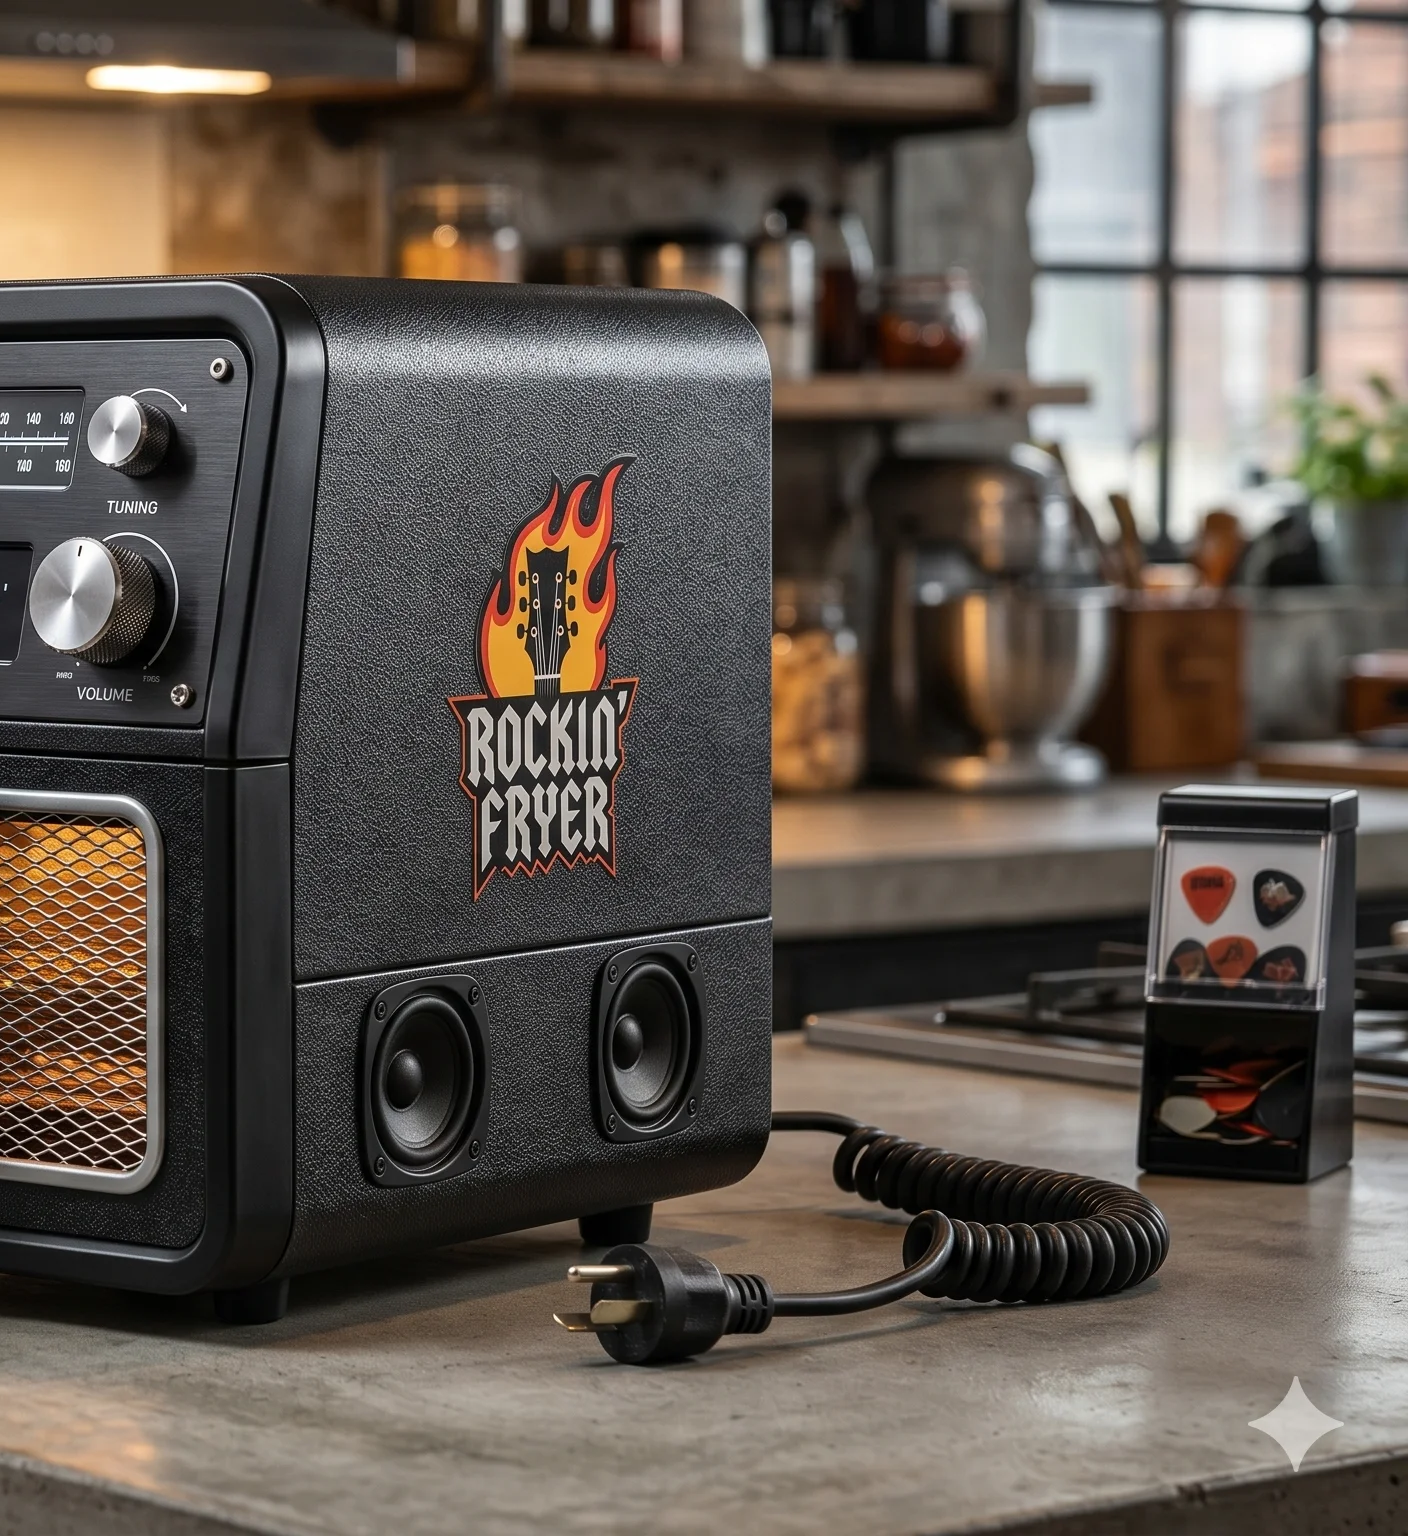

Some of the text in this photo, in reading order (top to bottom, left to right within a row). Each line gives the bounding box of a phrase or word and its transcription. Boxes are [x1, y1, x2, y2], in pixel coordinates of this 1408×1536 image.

[26, 412, 42, 425] 140
[59, 412, 75, 425] 160
[55, 459, 71, 472] 160
[107, 500, 158, 514] TUNING
[77, 686, 133, 702] VOLUME
[466, 690, 628, 788] ROCKIN'
[481, 776, 609, 873] FRYER
